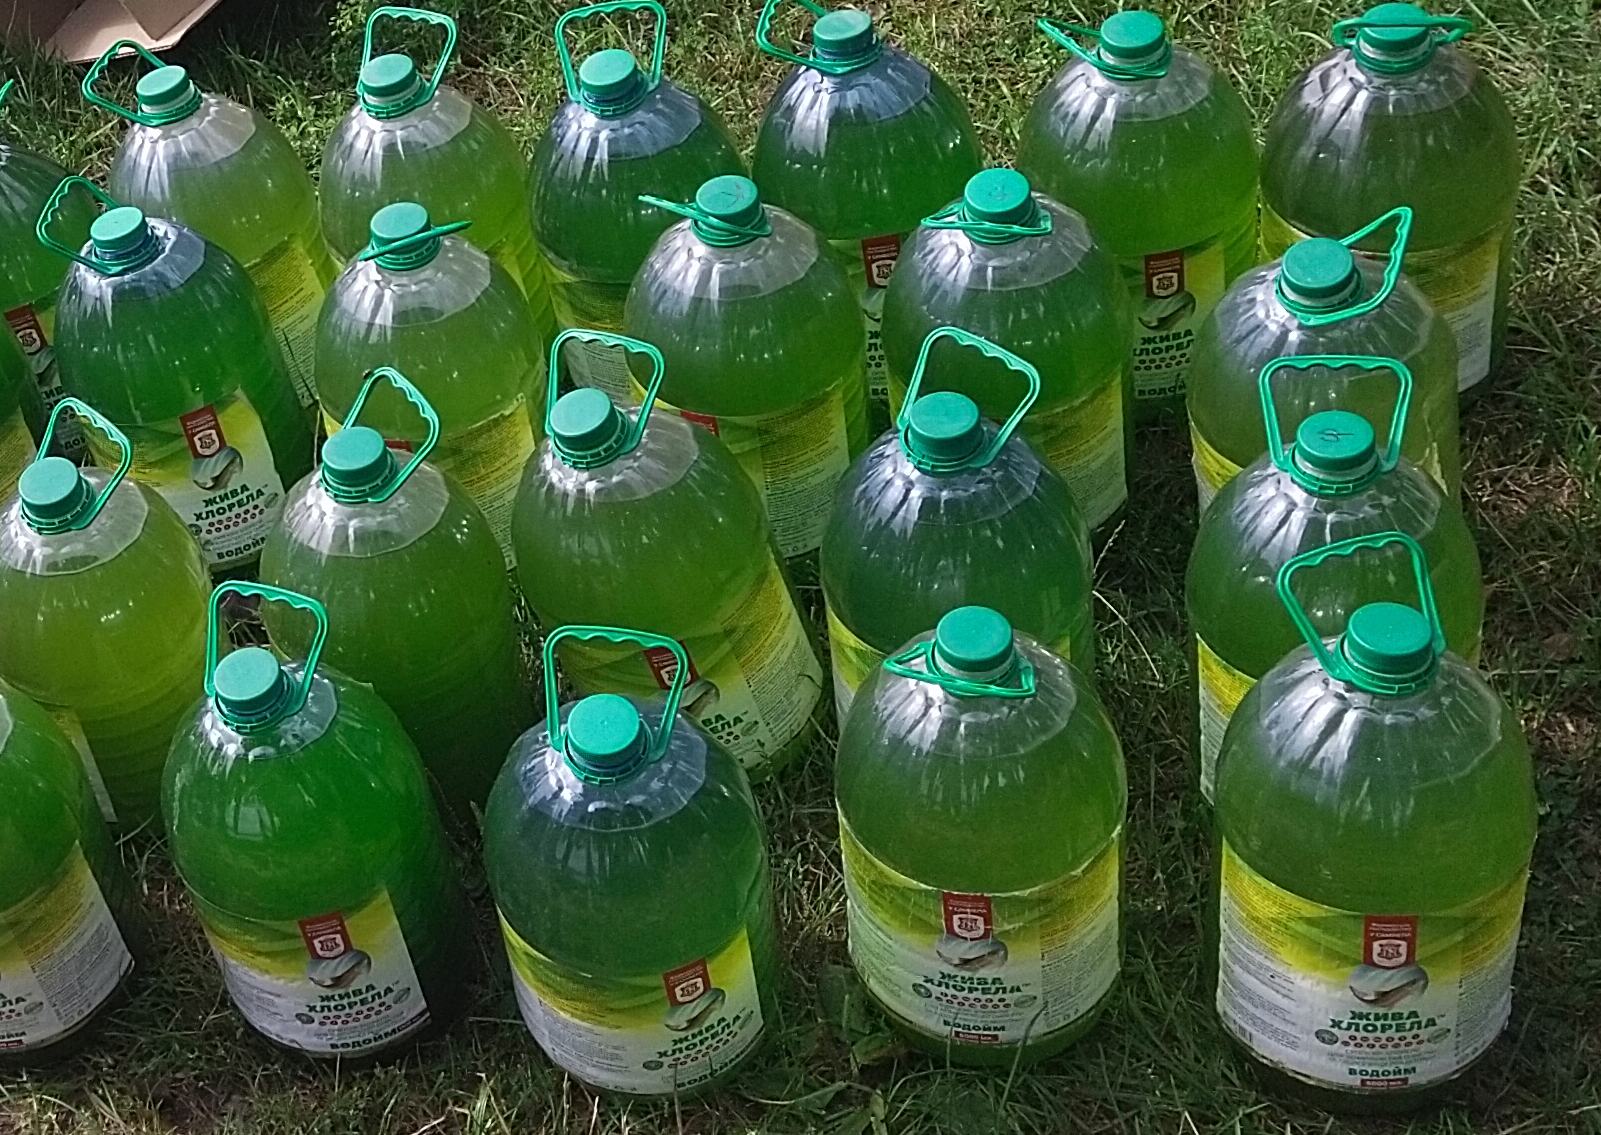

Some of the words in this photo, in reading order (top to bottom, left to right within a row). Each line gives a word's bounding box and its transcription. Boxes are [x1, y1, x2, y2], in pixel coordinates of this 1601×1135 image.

[1141, 328, 1194, 345] ЖИВА
[202, 483, 250, 508] ЖИВА
[193, 488, 266, 522] ХЛОРЕЛА
[923, 975, 1022, 996] ХЛОРЕЛА
[939, 970, 1004, 986] ЖИВА
[306, 985, 395, 1013] ХЛОРЕЛА
[318, 983, 377, 1003] ЖИВА
[1349, 1010, 1420, 1022] ЖИВА
[672, 1016, 727, 1046] ЖИВА
[943, 1019, 1006, 1032] ВОДОЙМ
[1329, 1017, 1437, 1034] ХЛОРЕЛА
[1349, 1066, 1417, 1078] ВОДОЙМ
